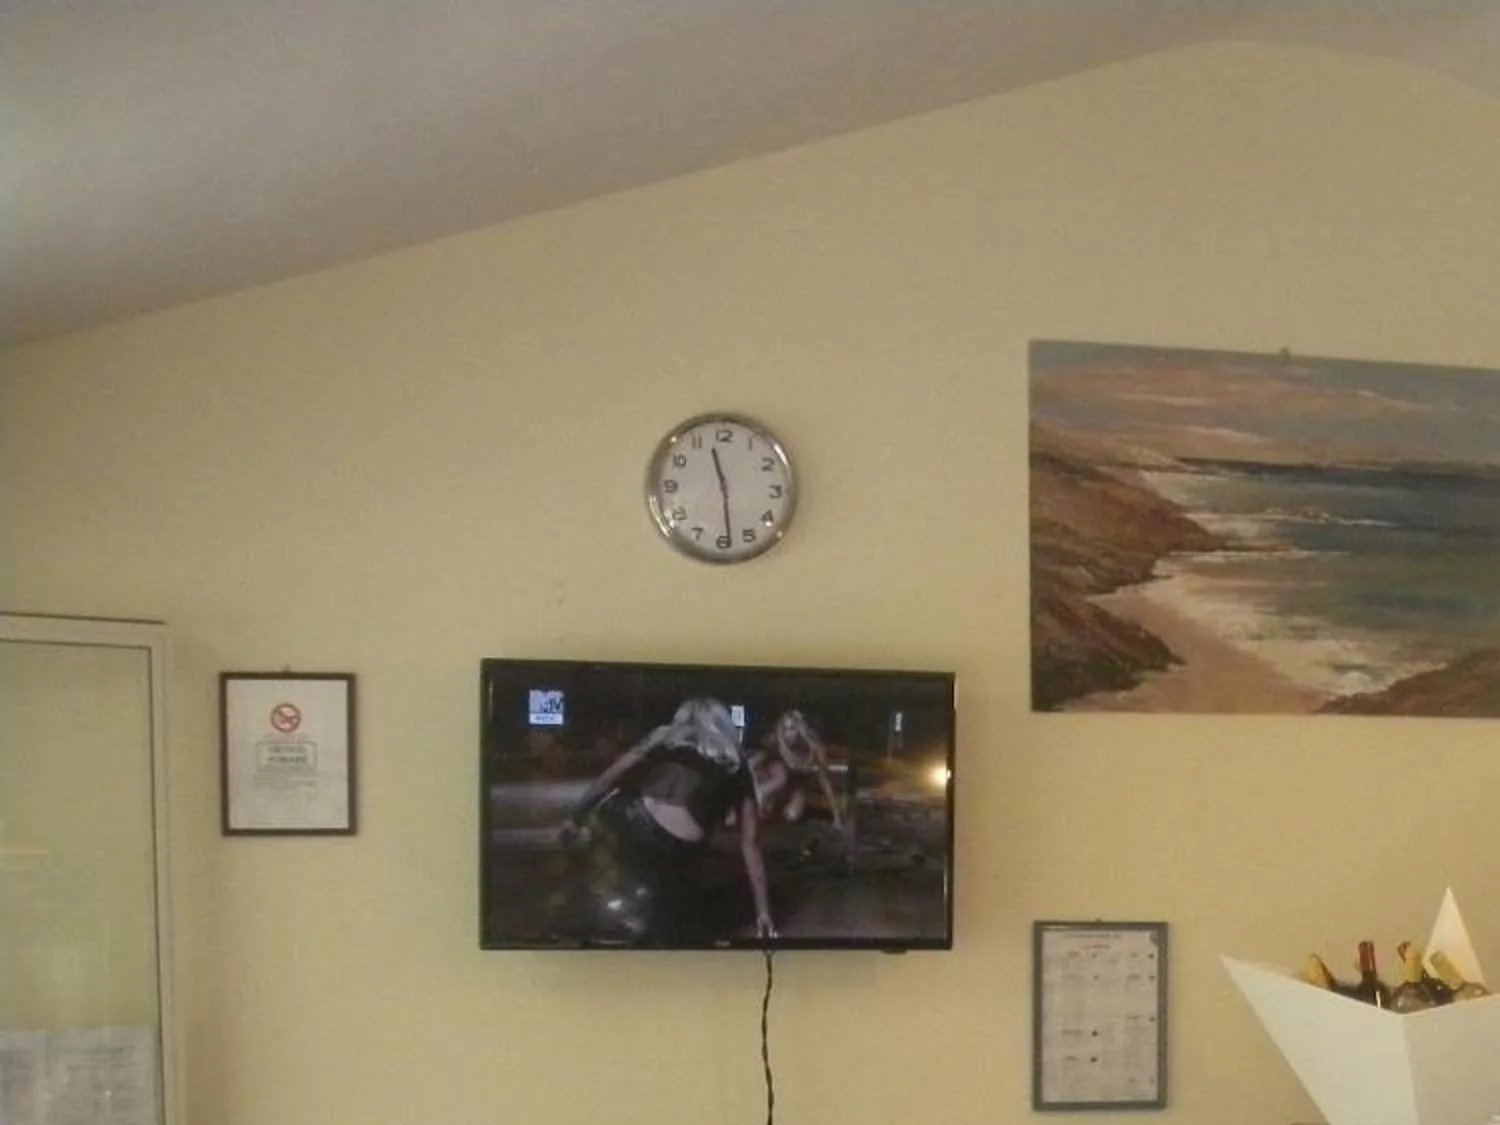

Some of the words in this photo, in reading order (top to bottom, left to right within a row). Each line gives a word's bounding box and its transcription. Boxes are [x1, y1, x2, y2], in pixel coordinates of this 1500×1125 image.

[715, 429, 733, 442] 12
[761, 457, 775, 472] 2
[769, 485, 782, 499] 3
[761, 509, 774, 527] 4
[692, 527, 703, 540] 7
[743, 529, 756, 543] 5
